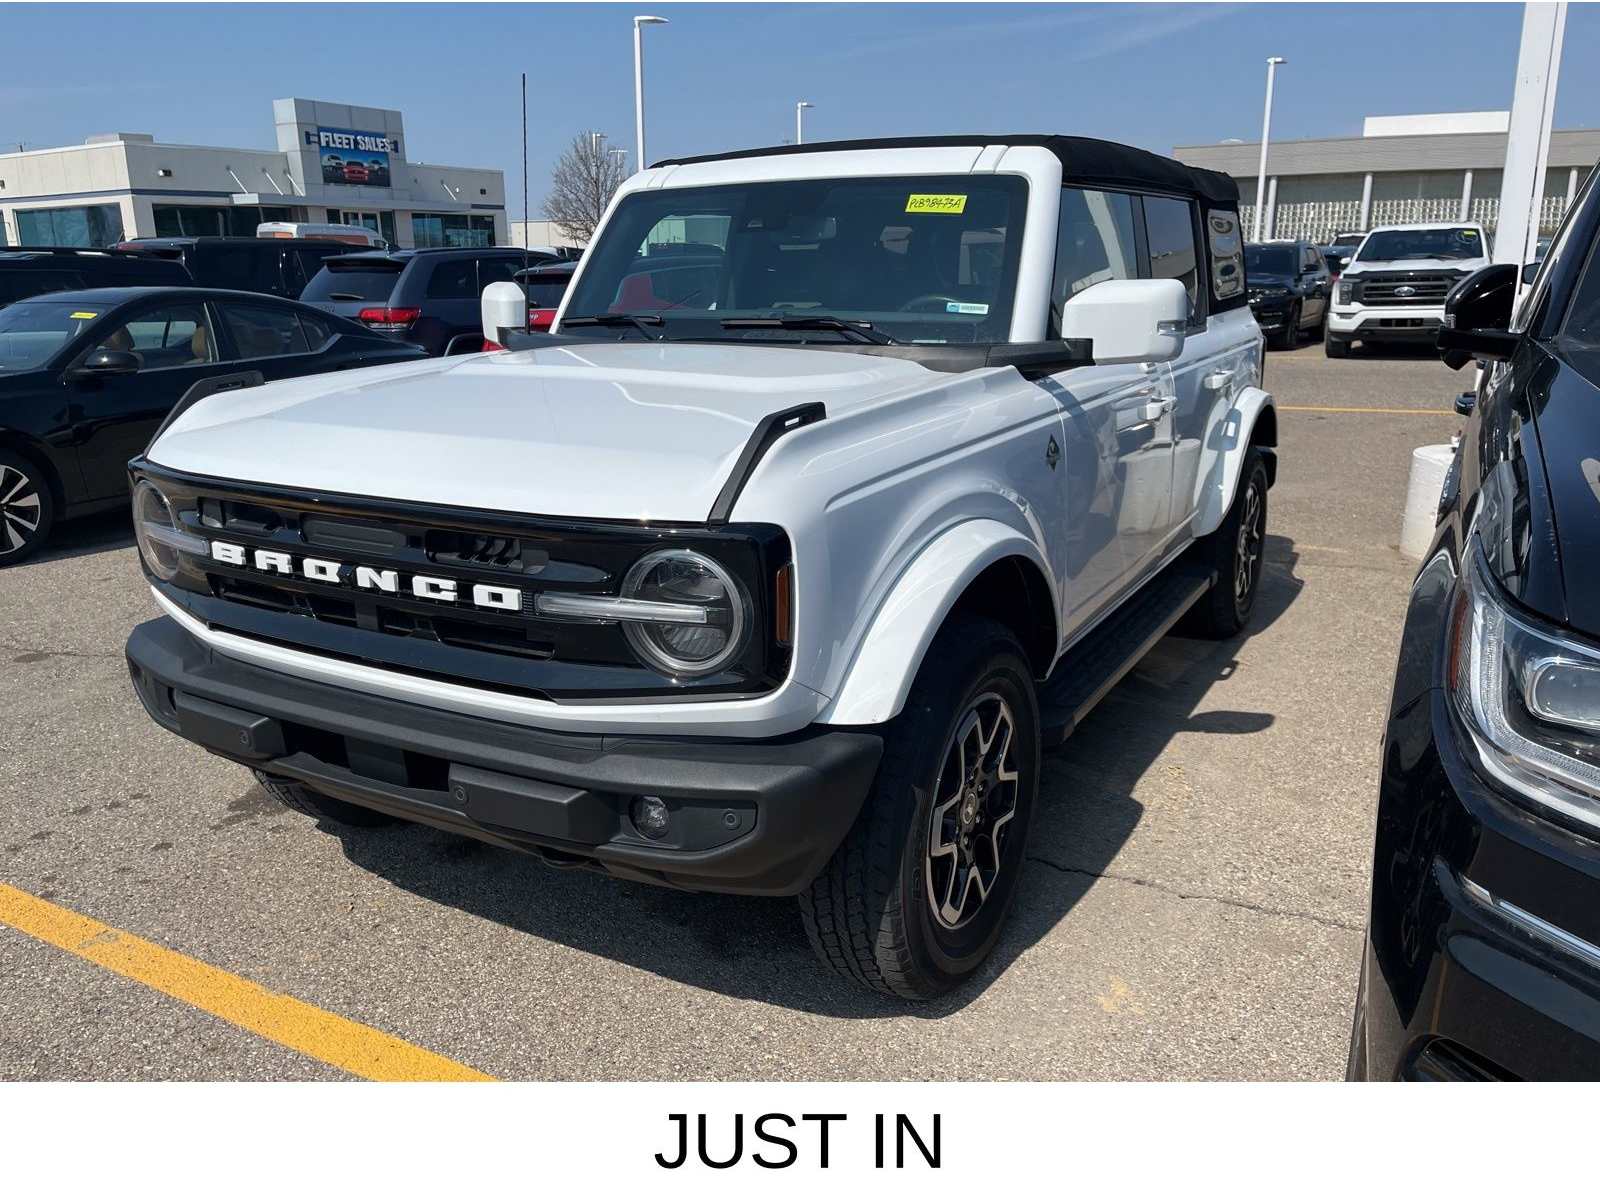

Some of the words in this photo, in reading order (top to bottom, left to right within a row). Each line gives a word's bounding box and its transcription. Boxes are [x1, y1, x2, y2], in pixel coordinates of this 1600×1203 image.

[320, 132, 355, 149] FLEET
[357, 135, 391, 152] SALES
[211, 540, 522, 611] BRONCO
